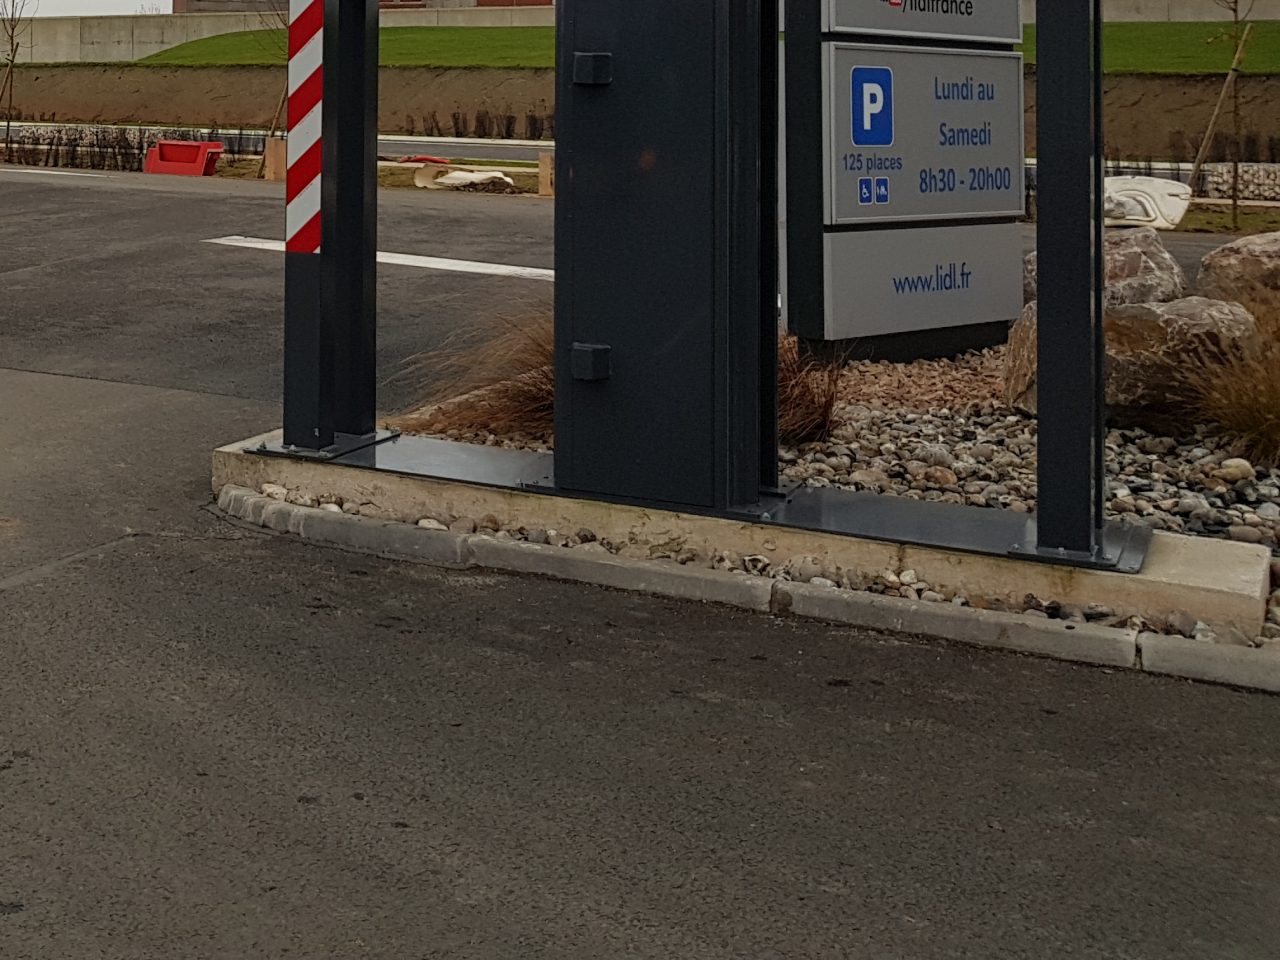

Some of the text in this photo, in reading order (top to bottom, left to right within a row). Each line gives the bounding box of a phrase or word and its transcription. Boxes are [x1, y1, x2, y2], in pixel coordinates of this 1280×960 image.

[934, 76, 995, 101] Lundi au
[862, 83, 885, 131] P
[938, 122, 992, 146] Samedi
[842, 153, 903, 174] 125 places
[919, 168, 956, 193] 8h30
[968, 167, 1011, 191] 20h00
[892, 262, 972, 294] www.lidl.fr
